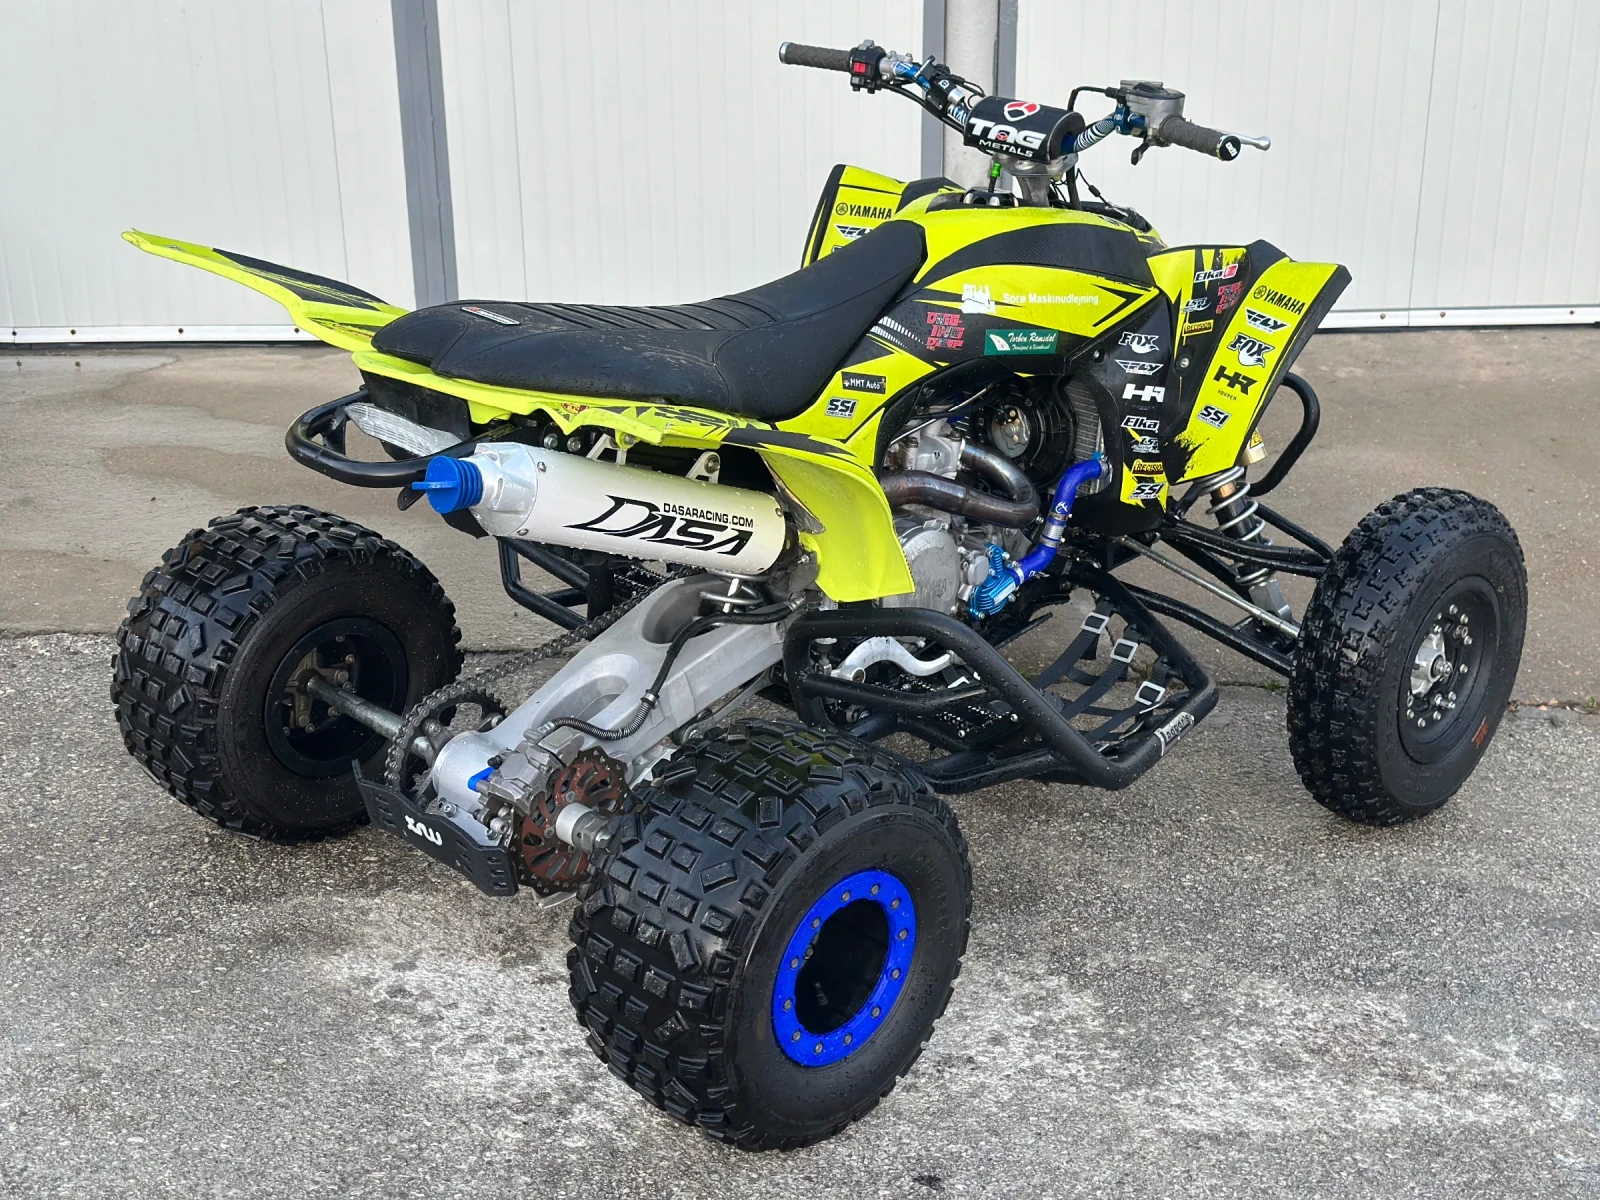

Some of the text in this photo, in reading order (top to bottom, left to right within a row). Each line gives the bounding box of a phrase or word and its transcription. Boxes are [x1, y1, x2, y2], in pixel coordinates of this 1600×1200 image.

[968, 117, 1047, 150] TAG
[979, 139, 1034, 158] METALS
[849, 204, 893, 220] YAMAHA
[1195, 270, 1223, 282] Elka
[1029, 293, 1099, 306] Maskinudlejning
[1263, 288, 1306, 315] YAMAHA
[1246, 308, 1288, 331] FLY
[1007, 332, 1028, 343] Torben
[1118, 331, 1159, 348] FOX
[1228, 333, 1273, 359] FOX
[1116, 361, 1162, 373] FLY
[850, 378, 880, 390] MMT Auto
[827, 398, 857, 414] SSI
[1122, 416, 1159, 429] Elka
[1199, 405, 1230, 426] SSI
[1133, 484, 1165, 496] SSI
[663, 502, 754, 529] DASARACING.COM
[562, 494, 754, 557] DASA
